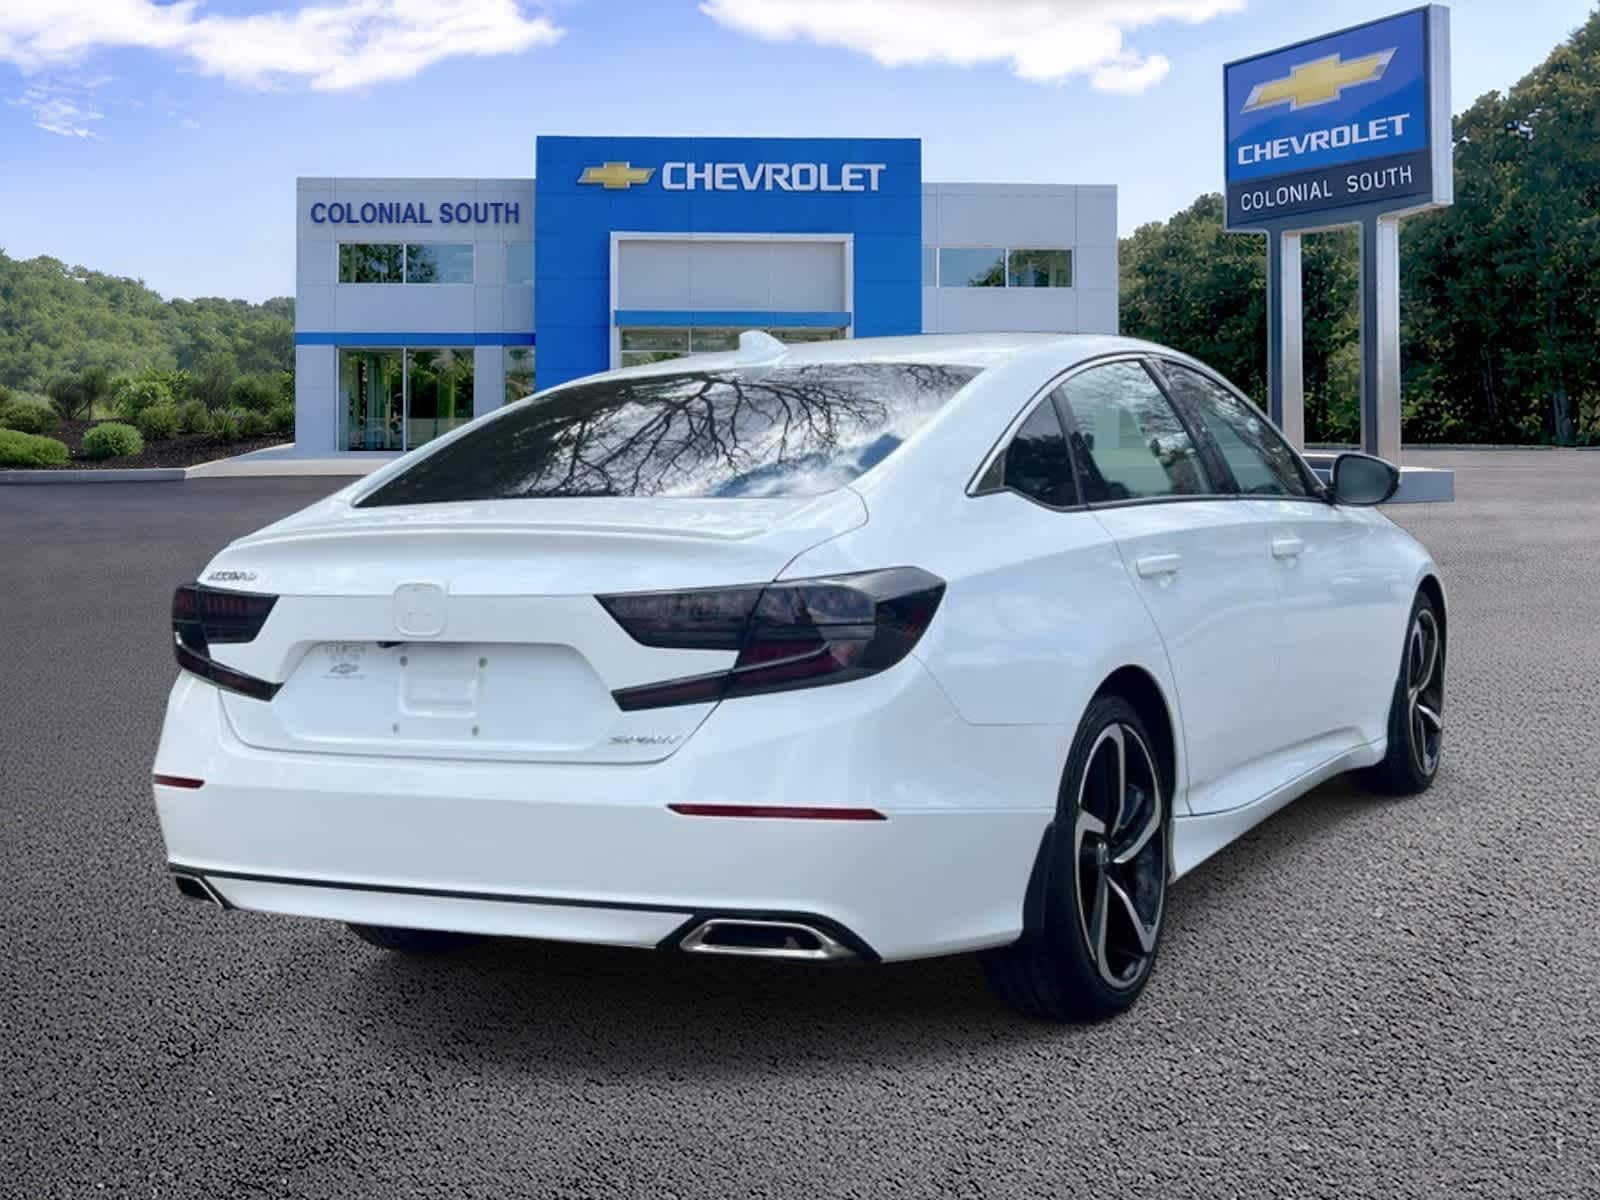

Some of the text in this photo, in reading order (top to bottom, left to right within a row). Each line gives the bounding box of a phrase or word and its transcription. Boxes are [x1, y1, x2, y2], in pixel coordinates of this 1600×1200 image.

[1237, 113, 1410, 165] CHEVROLET
[662, 162, 887, 192] CHEVROLET
[1240, 165, 1413, 212] COLONIAL SOUTH
[310, 202, 520, 225] COLONIAL SOUTH
